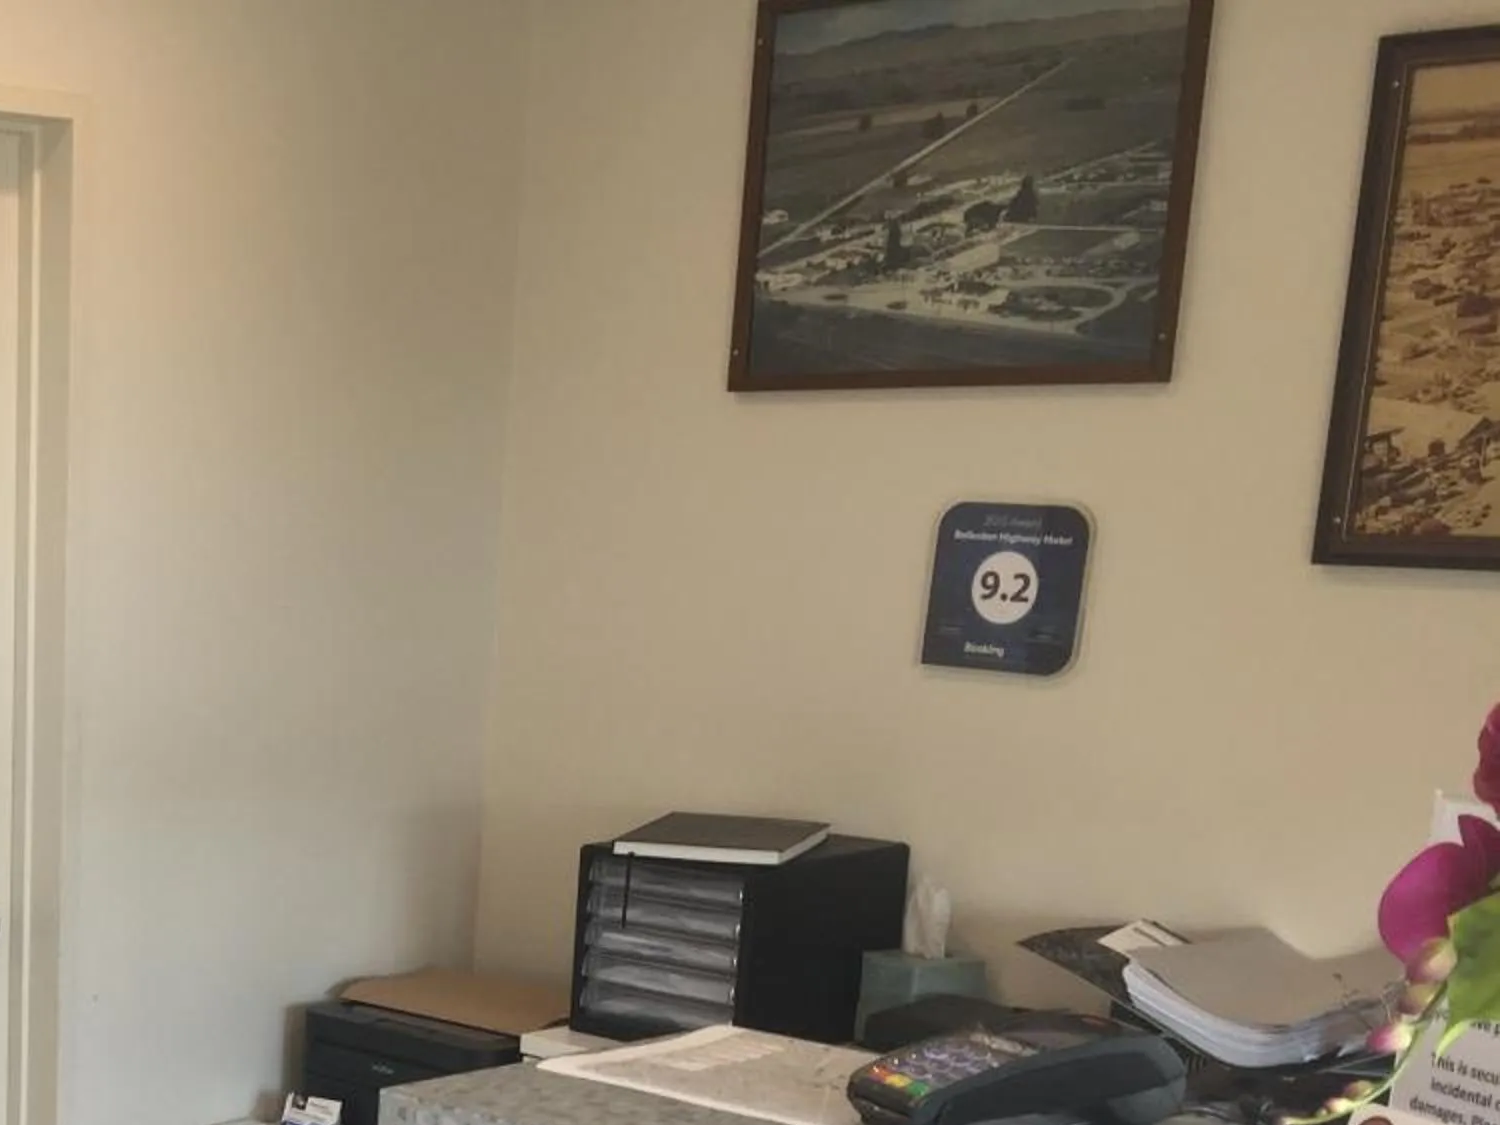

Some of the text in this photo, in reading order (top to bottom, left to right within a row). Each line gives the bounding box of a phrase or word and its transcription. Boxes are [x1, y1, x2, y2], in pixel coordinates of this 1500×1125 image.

[1000, 533, 1041, 546] Highway
[980, 571, 1031, 603] 9.2
[1458, 1060, 1468, 1075] is
[1431, 1077, 1492, 1107] incidental
[1410, 1097, 1466, 1125] damages.
